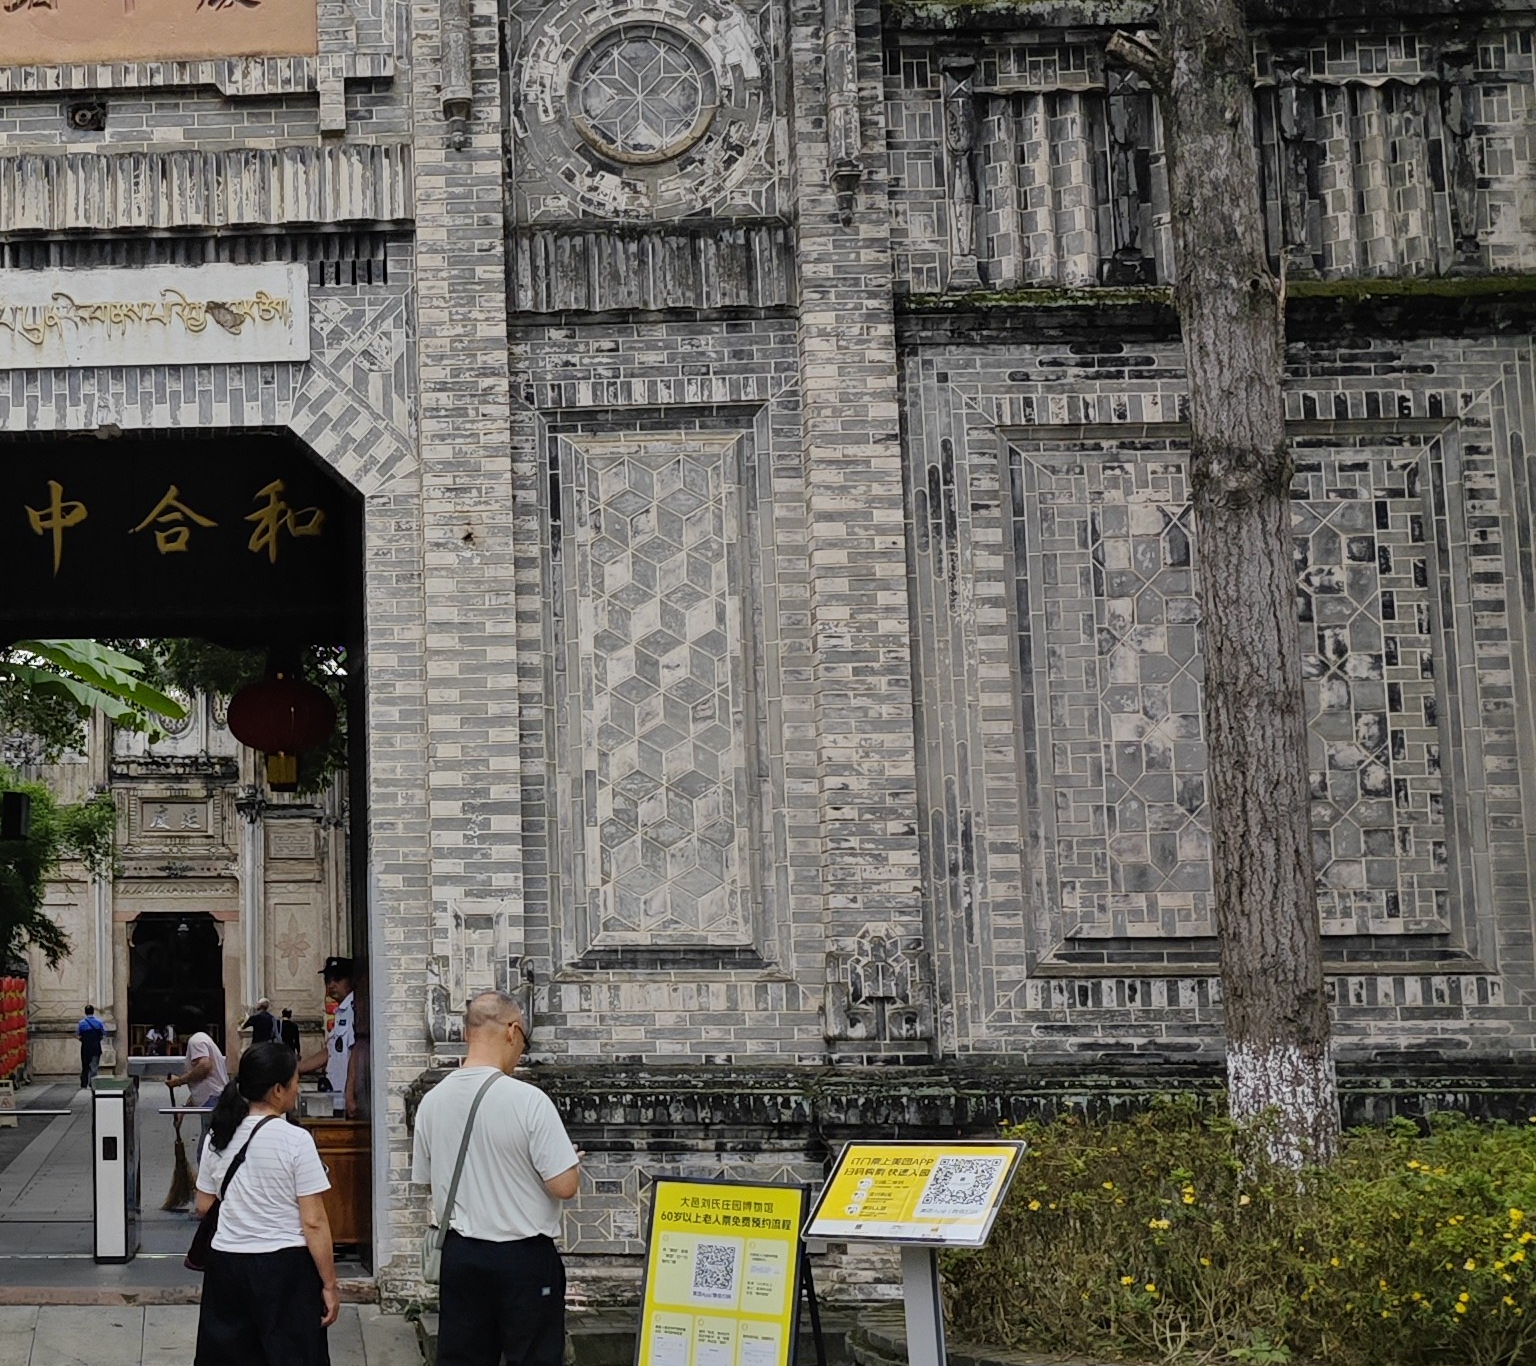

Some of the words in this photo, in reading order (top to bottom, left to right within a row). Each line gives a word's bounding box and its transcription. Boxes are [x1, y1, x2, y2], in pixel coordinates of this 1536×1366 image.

[680, 1197, 774, 1214] 大邑刘氏庄园博物馆
[660, 1211, 792, 1231] 60岁以上老人票免费预约流程
